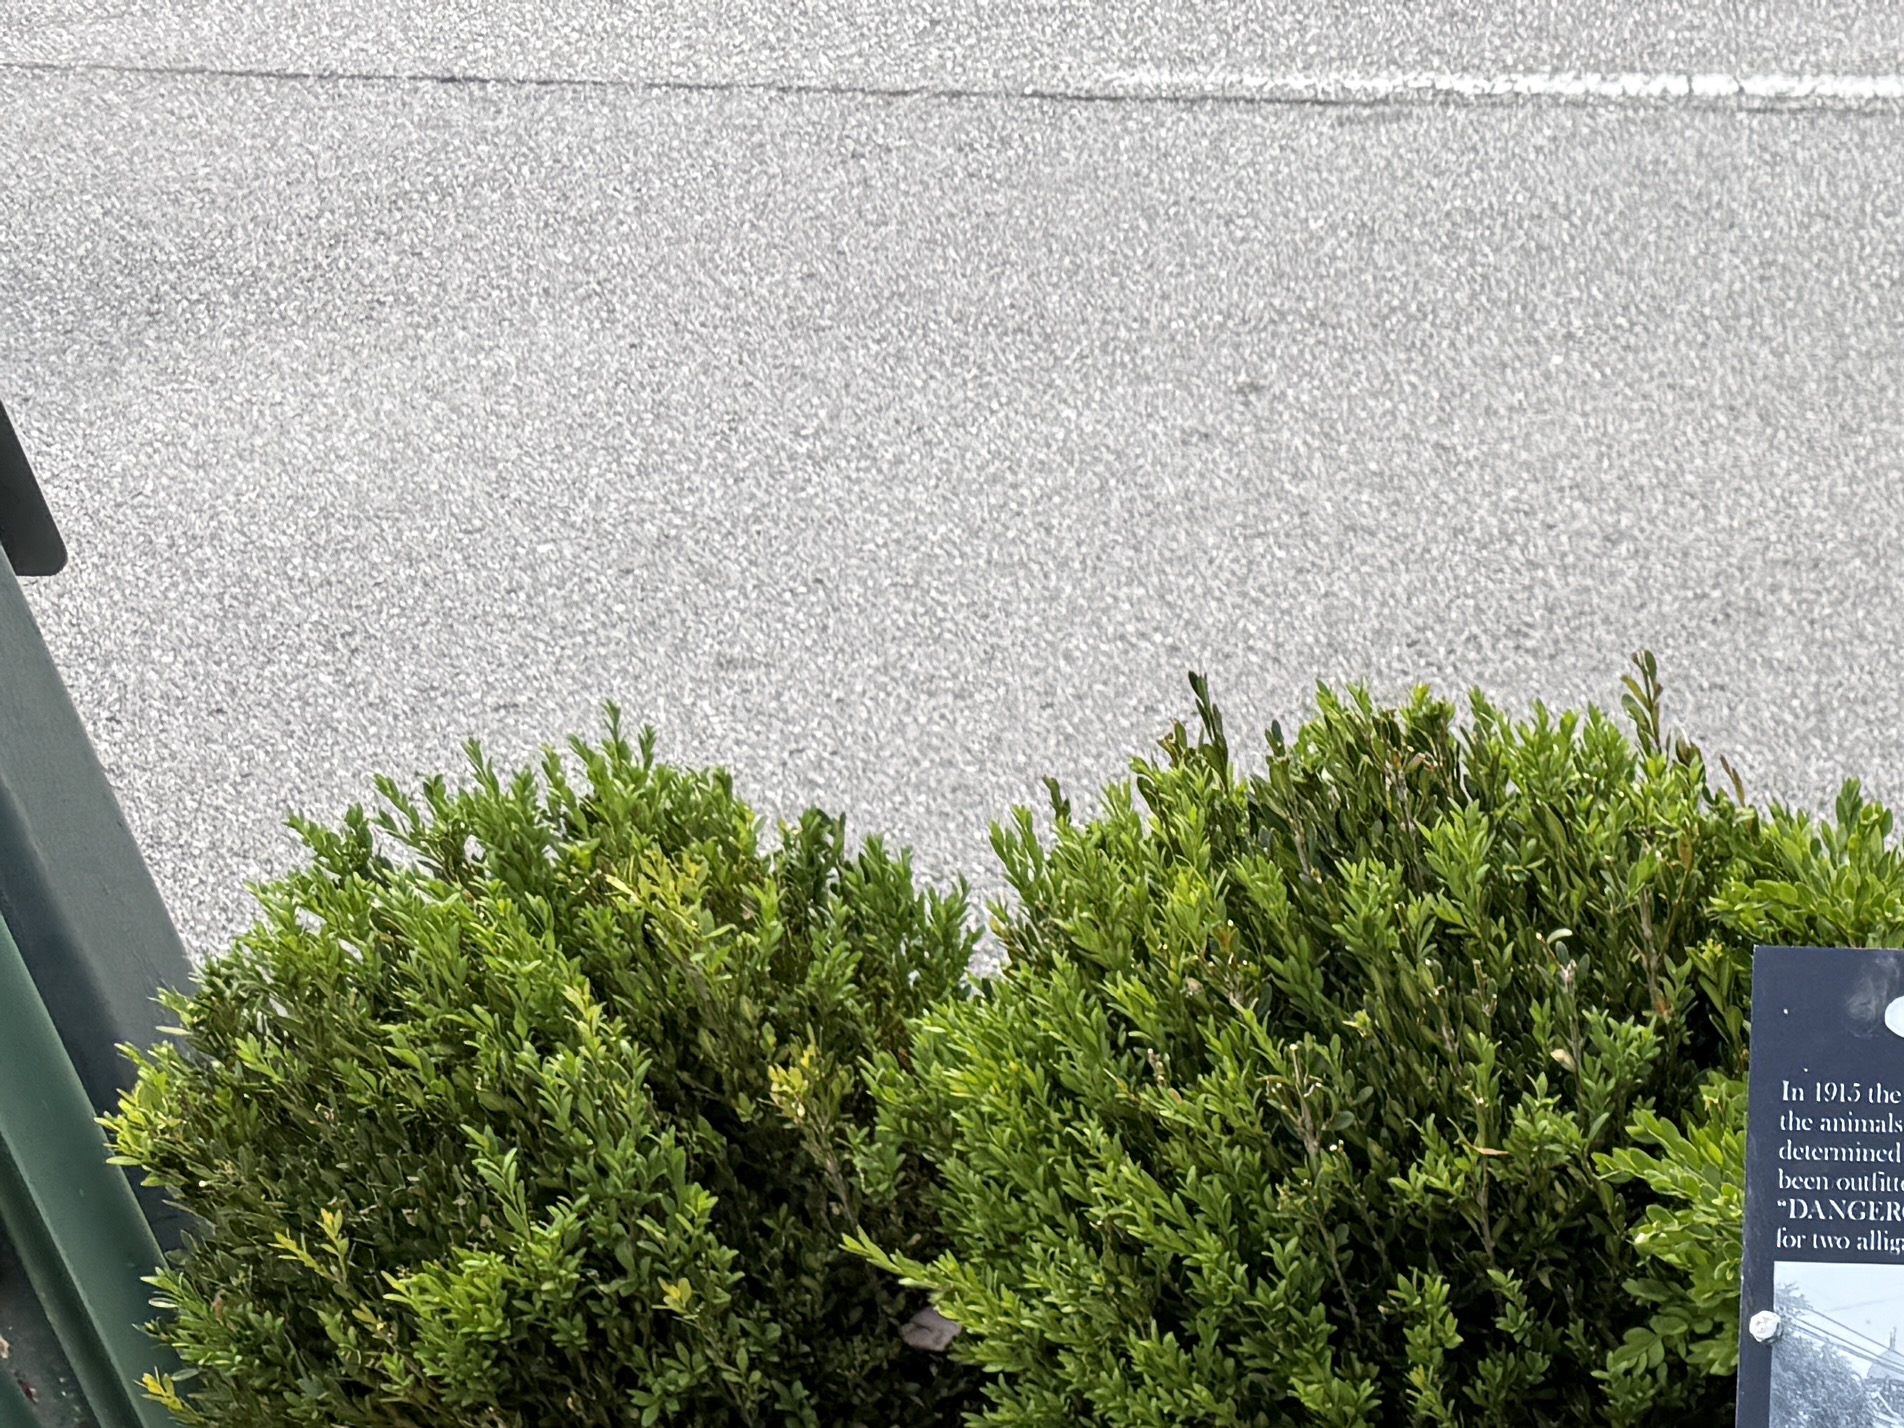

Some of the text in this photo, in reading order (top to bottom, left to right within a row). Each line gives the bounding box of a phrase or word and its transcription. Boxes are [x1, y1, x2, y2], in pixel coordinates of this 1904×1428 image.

[1783, 1080, 1804, 1101] In
[1816, 1082, 1860, 1102] 1915
[1869, 1083, 1901, 1104] the
[1779, 1139, 1901, 1163] determined
